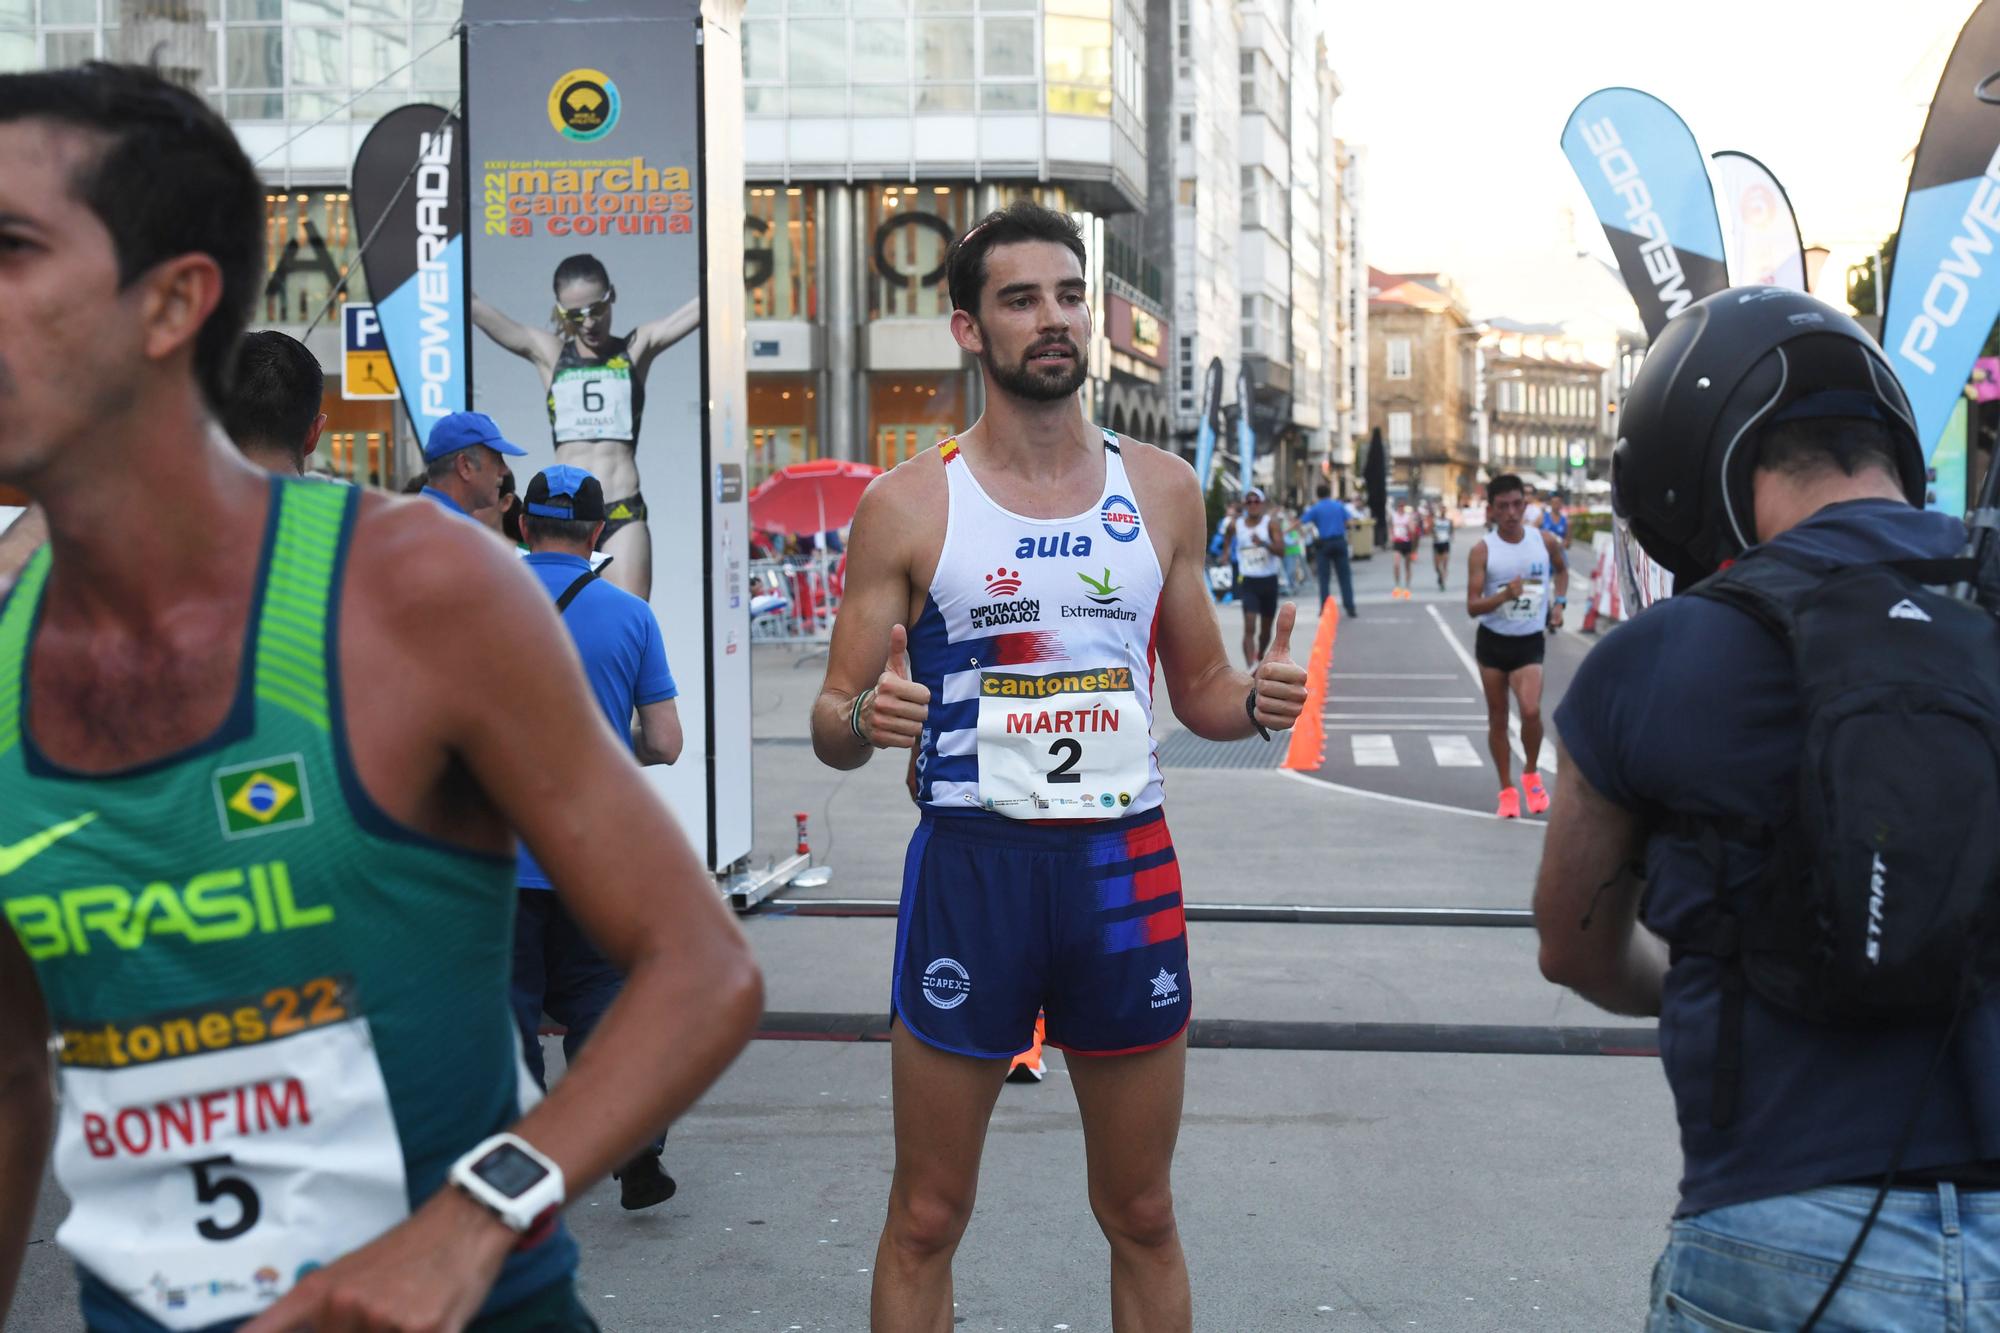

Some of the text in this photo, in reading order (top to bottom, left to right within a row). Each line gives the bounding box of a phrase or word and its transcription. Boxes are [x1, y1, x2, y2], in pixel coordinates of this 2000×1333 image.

[507, 156, 692, 194] marcha
[484, 172, 507, 236] 2022
[508, 192, 694, 215] cantones
[509, 216, 532, 237] a
[416, 126, 453, 418] POWERADE
[356, 310, 381, 348] P
[582, 379, 605, 413] 6
[1106, 512, 1136, 525] CAPEX
[1015, 532, 1093, 560] aula
[969, 597, 1041, 620] DIPUTACIÓN
[972, 610, 1041, 630] DE BADAJOZ
[1060, 605, 1138, 622] Extremadura
[983, 667, 1131, 697] cantones22
[1006, 702, 1120, 735] MARTÍN
[1046, 737, 1083, 784] 2
[3, 860, 336, 961] BRASIL
[929, 976, 963, 991] CAPEX
[1151, 992, 1181, 1009] luanvi
[83, 1076, 313, 1159] BONFIM
[190, 1154, 262, 1241] 5
